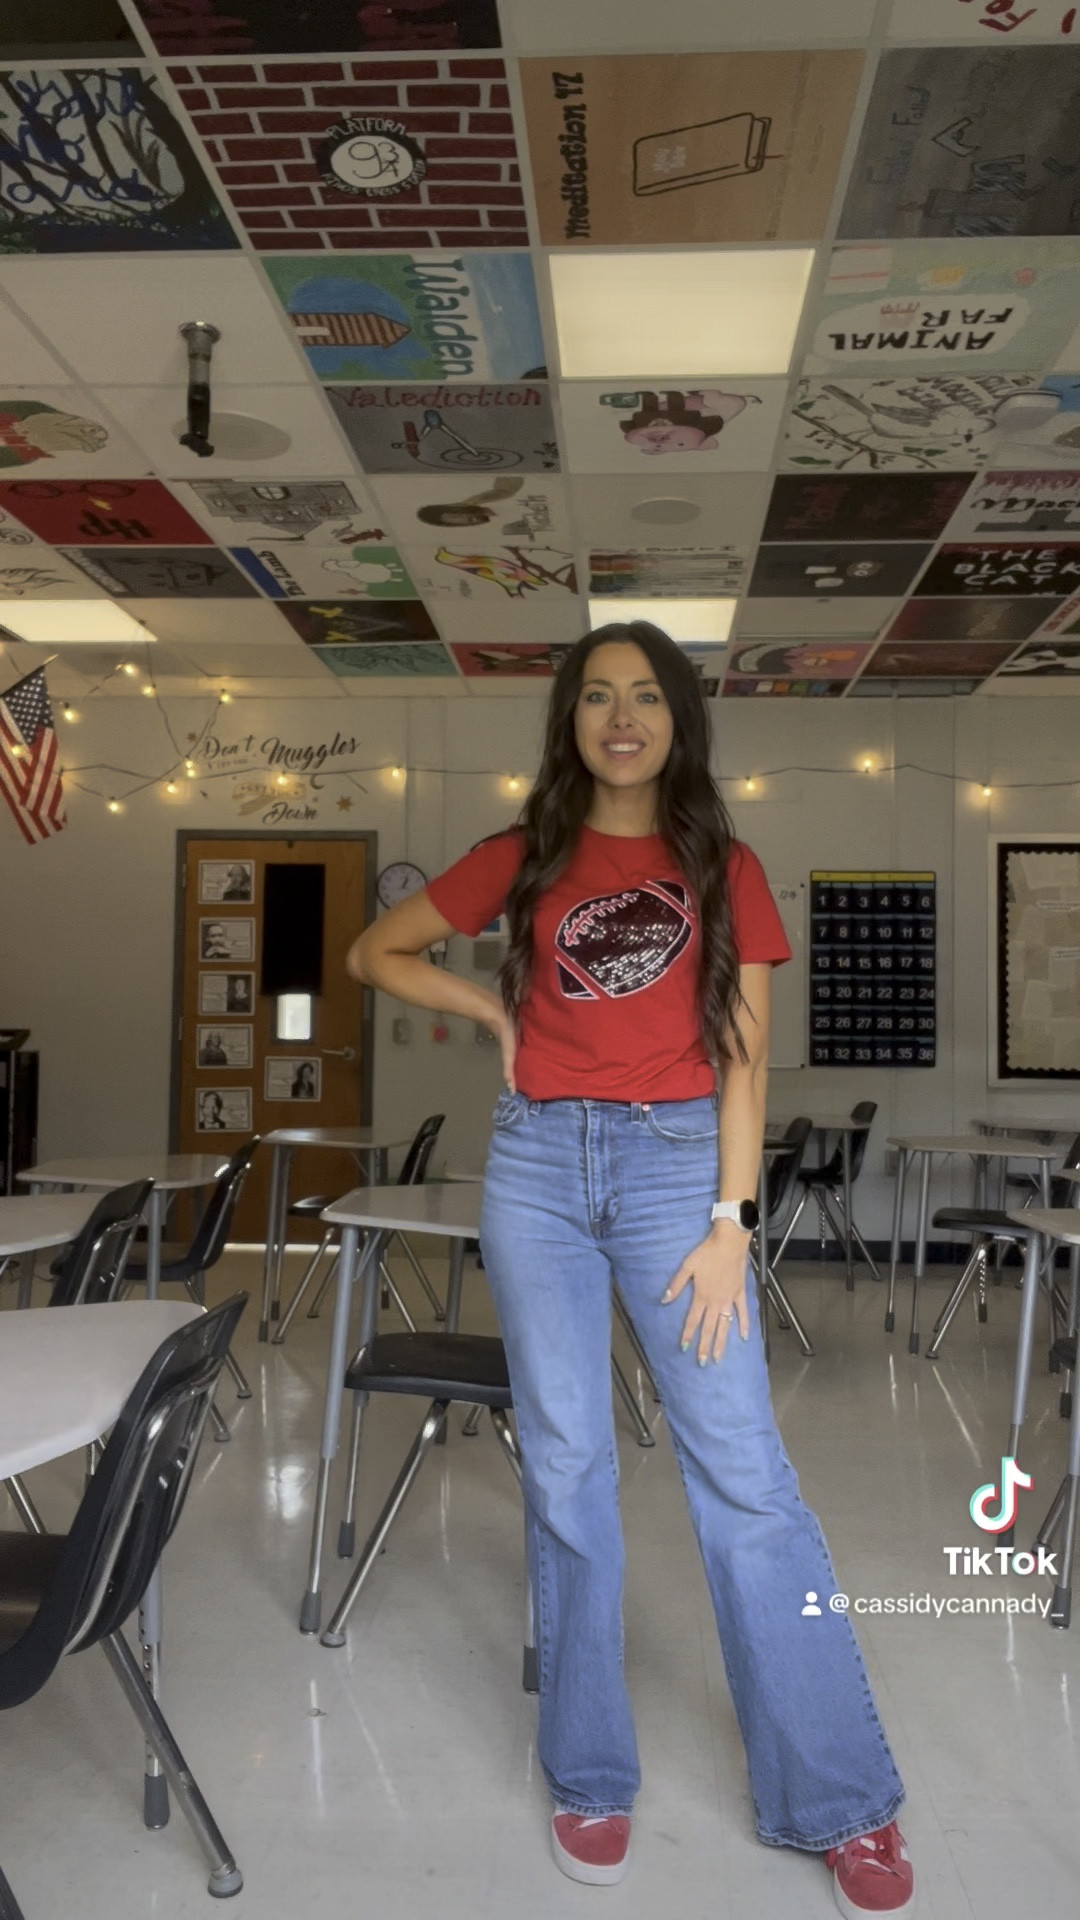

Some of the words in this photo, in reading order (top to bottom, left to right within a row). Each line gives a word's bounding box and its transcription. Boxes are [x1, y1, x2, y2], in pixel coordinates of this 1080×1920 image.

[325, 117, 407, 140] PLATFORM
[558, 103, 591, 240] Meditation
[404, 259, 478, 377] Walden
[827, 330, 996, 352] ANIMAL
[980, 549, 1058, 562] THE
[953, 562, 1080, 575] BLACK
[964, 574, 1053, 586] CAT
[200, 733, 256, 760] Don't
[261, 732, 361, 771] Muggles
[262, 802, 320, 826] Down
[819, 896, 826, 906] 1
[839, 896, 847, 908] 2
[860, 897, 868, 908] 3
[880, 896, 888, 906] 4
[902, 896, 910, 906] 5
[921, 897, 930, 908] 6
[820, 926, 827, 938] 7
[840, 926, 848, 938] 8
[860, 927, 868, 938] 9
[878, 927, 892, 938] 10
[901, 928, 913, 938] 11
[920, 928, 933, 938] 12
[816, 957, 830, 968] 13
[837, 957, 850, 968] 14
[858, 958, 871, 969] 15
[878, 957, 892, 968] 16
[901, 957, 913, 968] 17
[920, 958, 933, 968] 18
[817, 986, 830, 998] 19
[836, 986, 852, 998] 20
[858, 987, 872, 999] 21
[877, 987, 892, 998] 22
[899, 988, 914, 1000] 23
[920, 988, 934, 1000] 24
[815, 1016, 830, 1028] 25
[835, 1016, 851, 1028] 26
[856, 1017, 872, 1029] 27
[877, 1017, 892, 1029] 28
[899, 1018, 914, 1030] 29
[918, 1018, 934, 1029] 30
[816, 1048, 828, 1059] 31
[834, 1048, 850, 1060] 32
[856, 1048, 871, 1060] 33
[876, 1048, 892, 1060] 34
[897, 1048, 912, 1059] 35
[918, 1048, 934, 1060] 36
